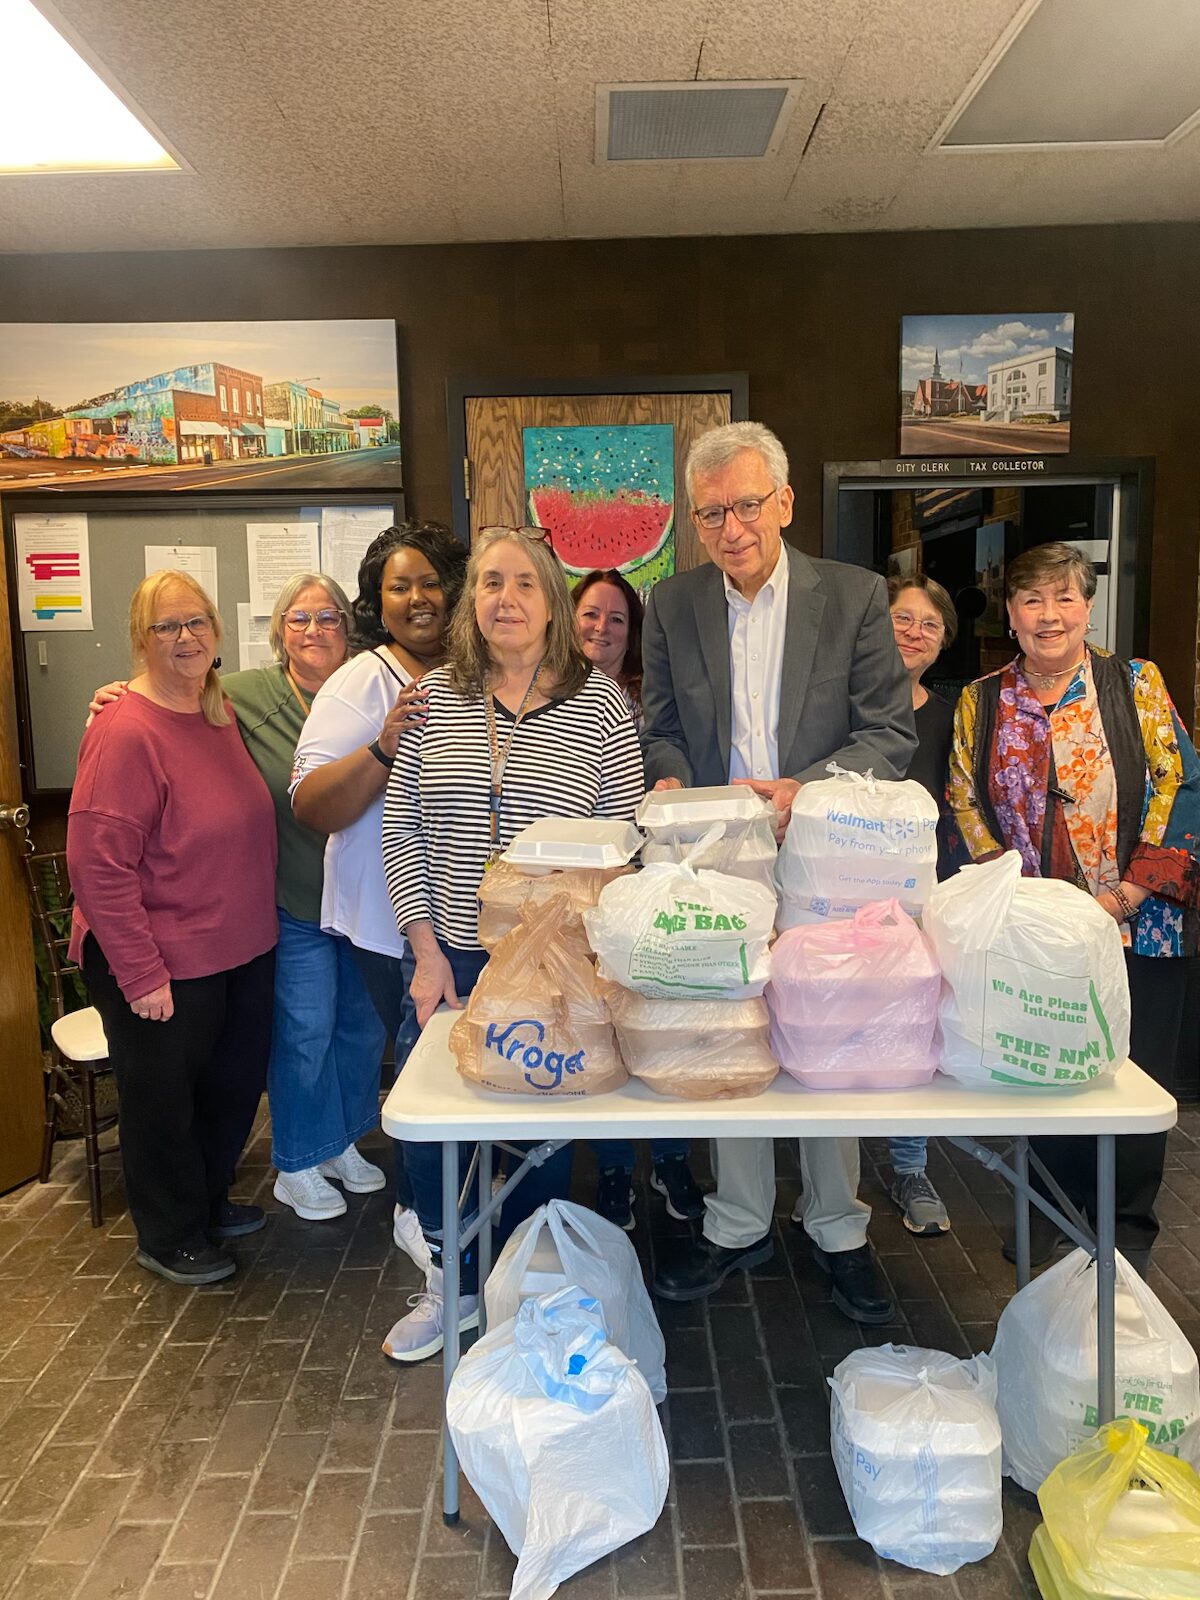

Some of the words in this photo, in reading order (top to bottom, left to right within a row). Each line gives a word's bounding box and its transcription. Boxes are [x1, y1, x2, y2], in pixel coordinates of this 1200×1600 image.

[896, 463, 915, 472] CITY
[921, 462, 950, 472] CLERK
[970, 462, 987, 471] TAX
[992, 460, 1045, 471] COLLECTOR
[826, 808, 886, 833] Walmart
[828, 833, 848, 848] Pay
[850, 838, 876, 852] from
[695, 914, 747, 930] BAG
[992, 979, 1014, 996] We
[1019, 989, 1043, 1004] Are
[996, 1031, 1050, 1059] THE
[1002, 1053, 1047, 1077] BIG
[1054, 1064, 1099, 1080] BAG
[1123, 1392, 1163, 1415] THE
[856, 1453, 881, 1480] Pay
